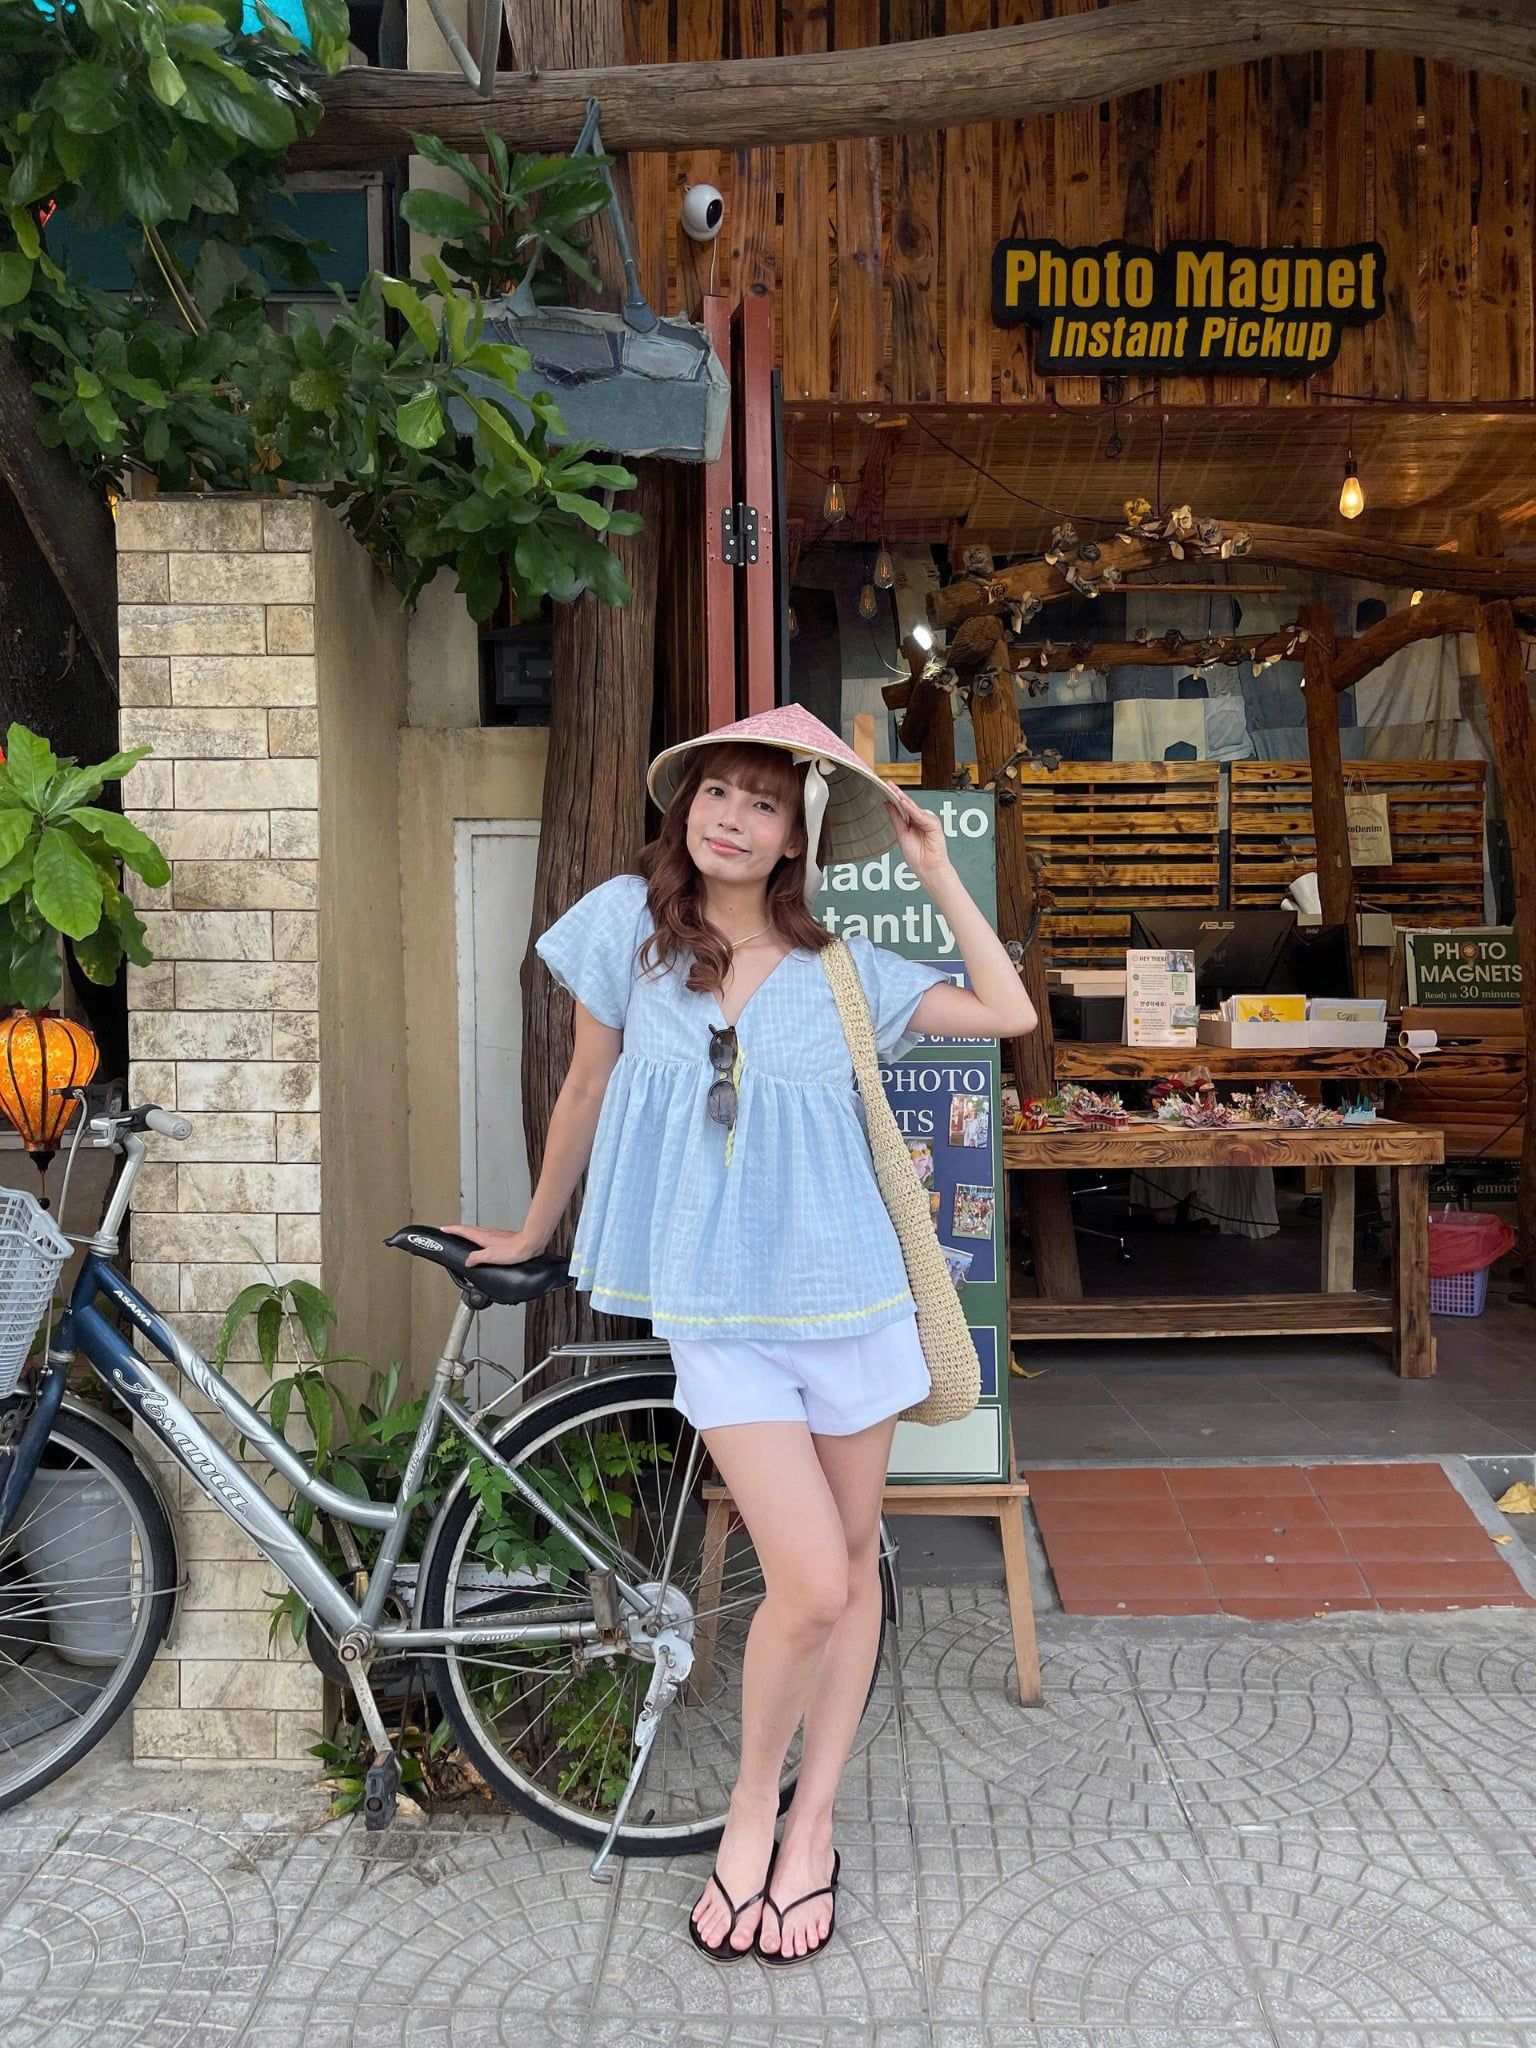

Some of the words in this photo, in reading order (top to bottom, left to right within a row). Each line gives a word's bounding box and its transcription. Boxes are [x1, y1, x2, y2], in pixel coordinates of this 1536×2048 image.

[1005, 250, 1154, 307] Photo
[1175, 251, 1376, 313] Magnet
[1049, 316, 1188, 358] Instant
[1200, 317, 1331, 361] Pickup
[923, 801, 989, 838] to
[813, 904, 956, 954] tantly
[1199, 921, 1235, 930] ASUS
[1420, 964, 1523, 983] MAGNETS
[1425, 991, 1447, 1000] Ready
[1449, 991, 1458, 999] in
[1460, 985, 1479, 999] 30
[1481, 990, 1521, 999] minutes
[880, 1068, 986, 1092] PHOTO
[895, 1109, 935, 1133] TS
[1472, 1181, 1519, 1194] emori
[113, 1289, 152, 1327] ASAMA
[112, 1368, 249, 1514] Asama
